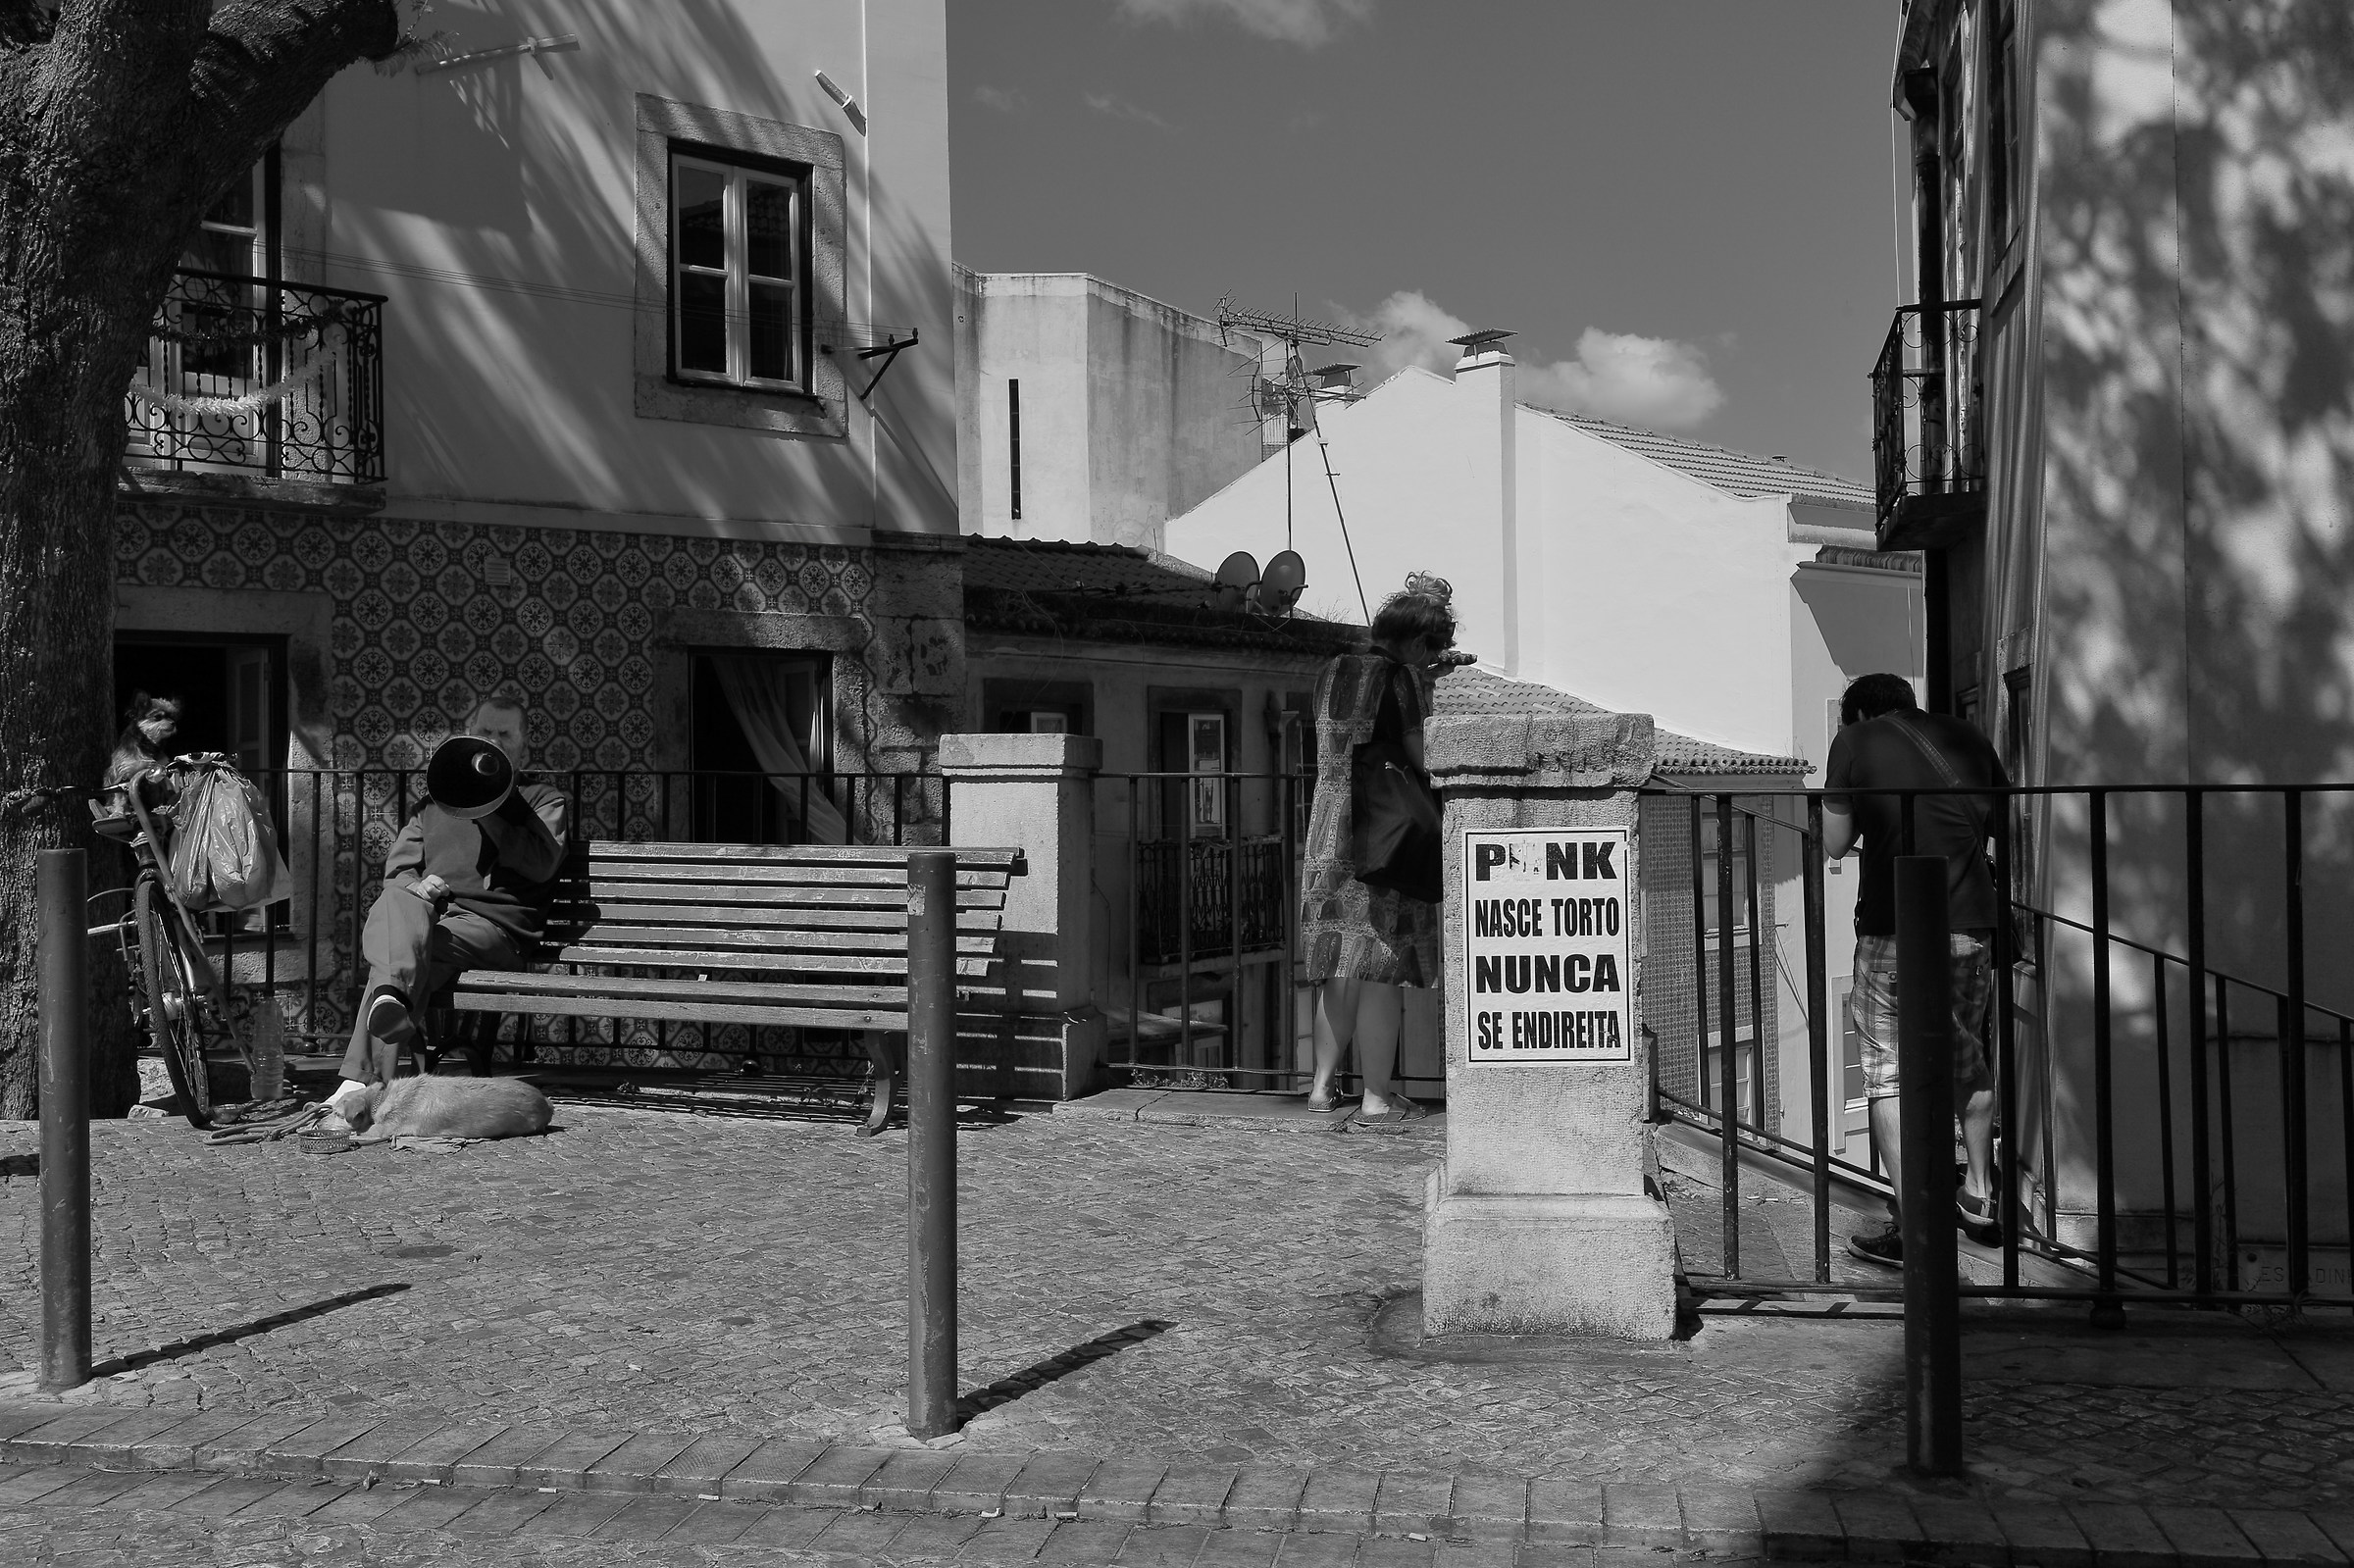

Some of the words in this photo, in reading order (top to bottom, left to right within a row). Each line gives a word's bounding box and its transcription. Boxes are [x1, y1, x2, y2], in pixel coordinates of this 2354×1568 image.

[1475, 841, 1617, 882] PNK
[1474, 898, 1543, 938] NASCE
[1551, 896, 1620, 937] TORTO
[1475, 953, 1621, 994] NUNCA
[1477, 1011, 1504, 1050] SE
[1511, 1010, 1621, 1049] ENDIREITA
